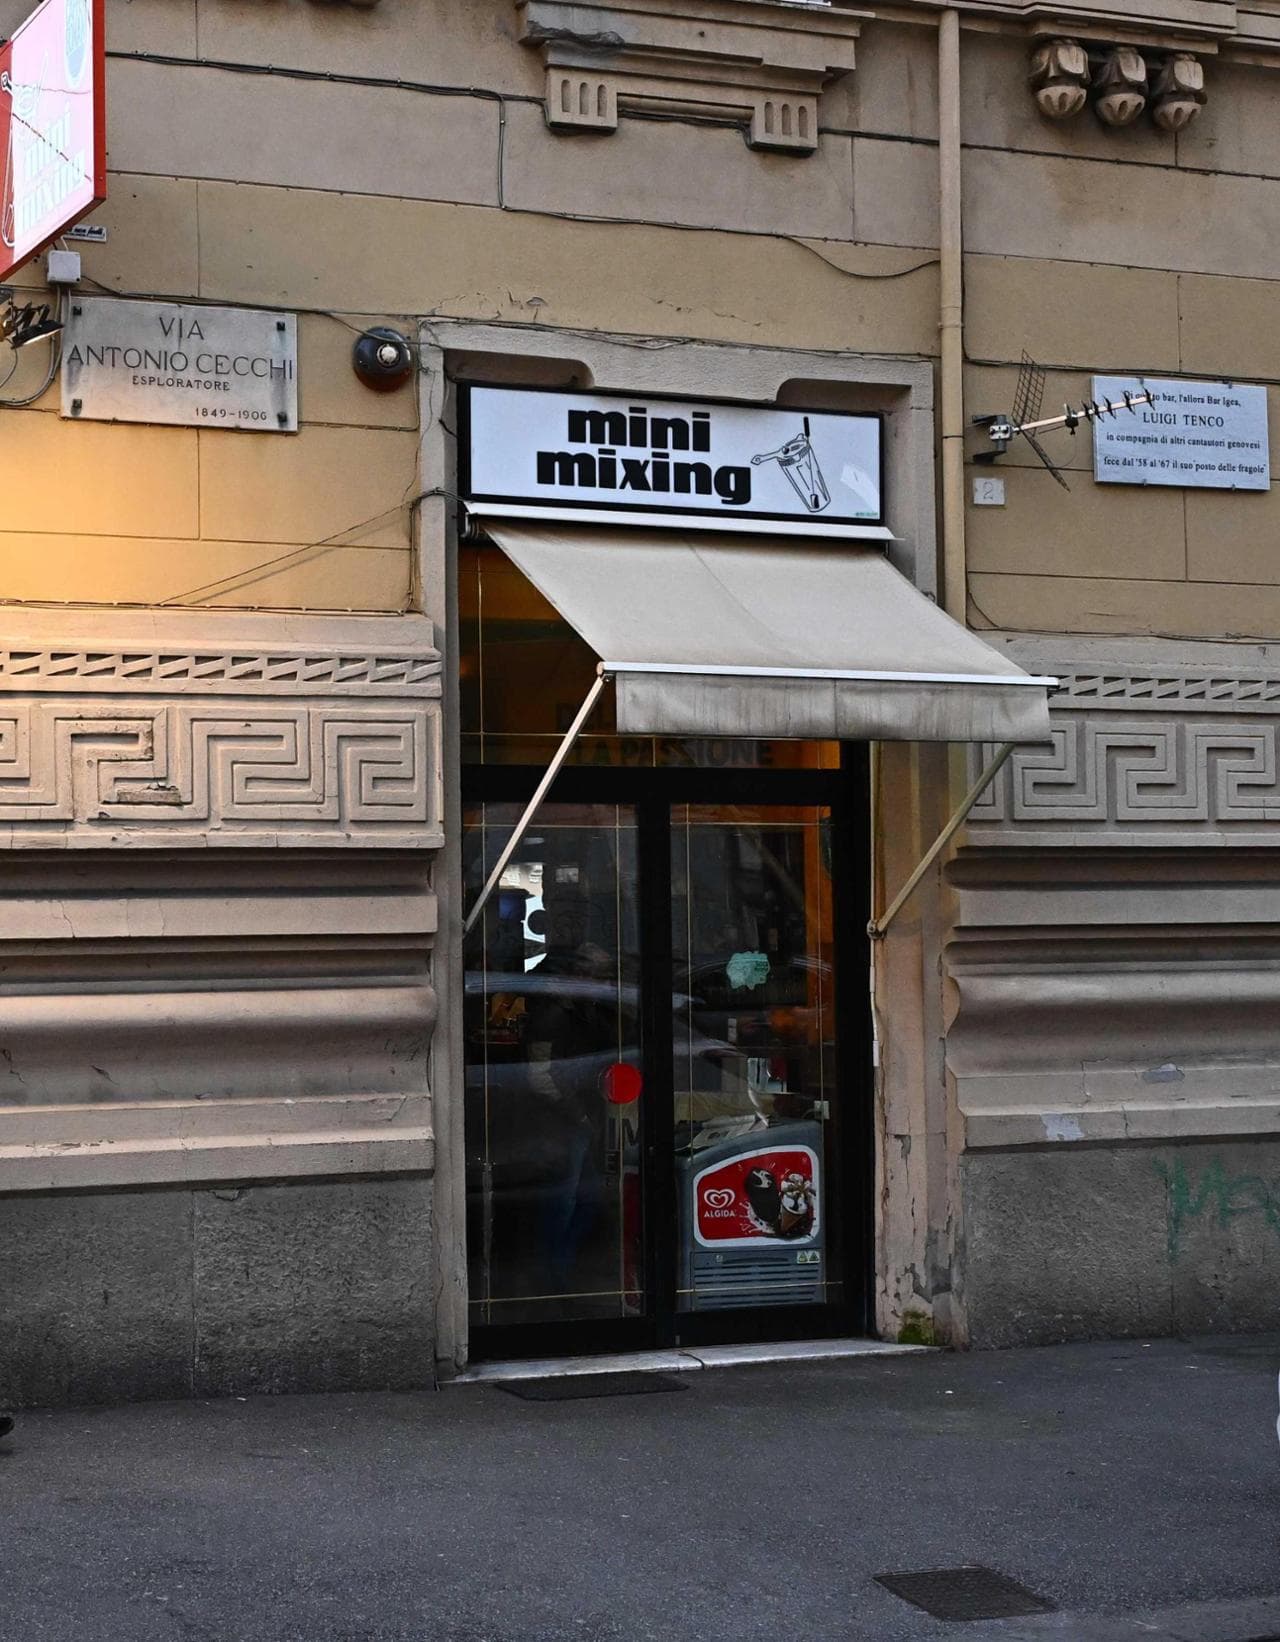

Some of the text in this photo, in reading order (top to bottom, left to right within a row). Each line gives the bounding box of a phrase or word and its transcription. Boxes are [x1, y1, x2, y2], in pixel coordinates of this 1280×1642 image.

[159, 315, 205, 341] VIA
[67, 344, 293, 380] ANTONIO CECCHI
[132, 375, 231, 391] ESPLORATORE
[1163, 392, 1177, 403] bar,
[1179, 394, 1205, 405] l'allora
[1207, 395, 1220, 405] Bar
[1223, 396, 1241, 407] Igea,
[195, 407, 267, 421] 1849-1906
[1143, 412, 1225, 428] LUIGI TENCO
[568, 406, 710, 453] mini
[1106, 432, 1261, 450] in compagnia di altri cantautori genovesi
[1103, 456, 1120, 466] fece
[1122, 457, 1134, 466] dal
[1149, 459, 1157, 468] al
[1172, 460, 1178, 469] il
[1180, 462, 1193, 470] suo
[1218, 463, 1236, 472] delle
[536, 447, 752, 506] mixing
[704, 1208, 736, 1219] ALGIDA
